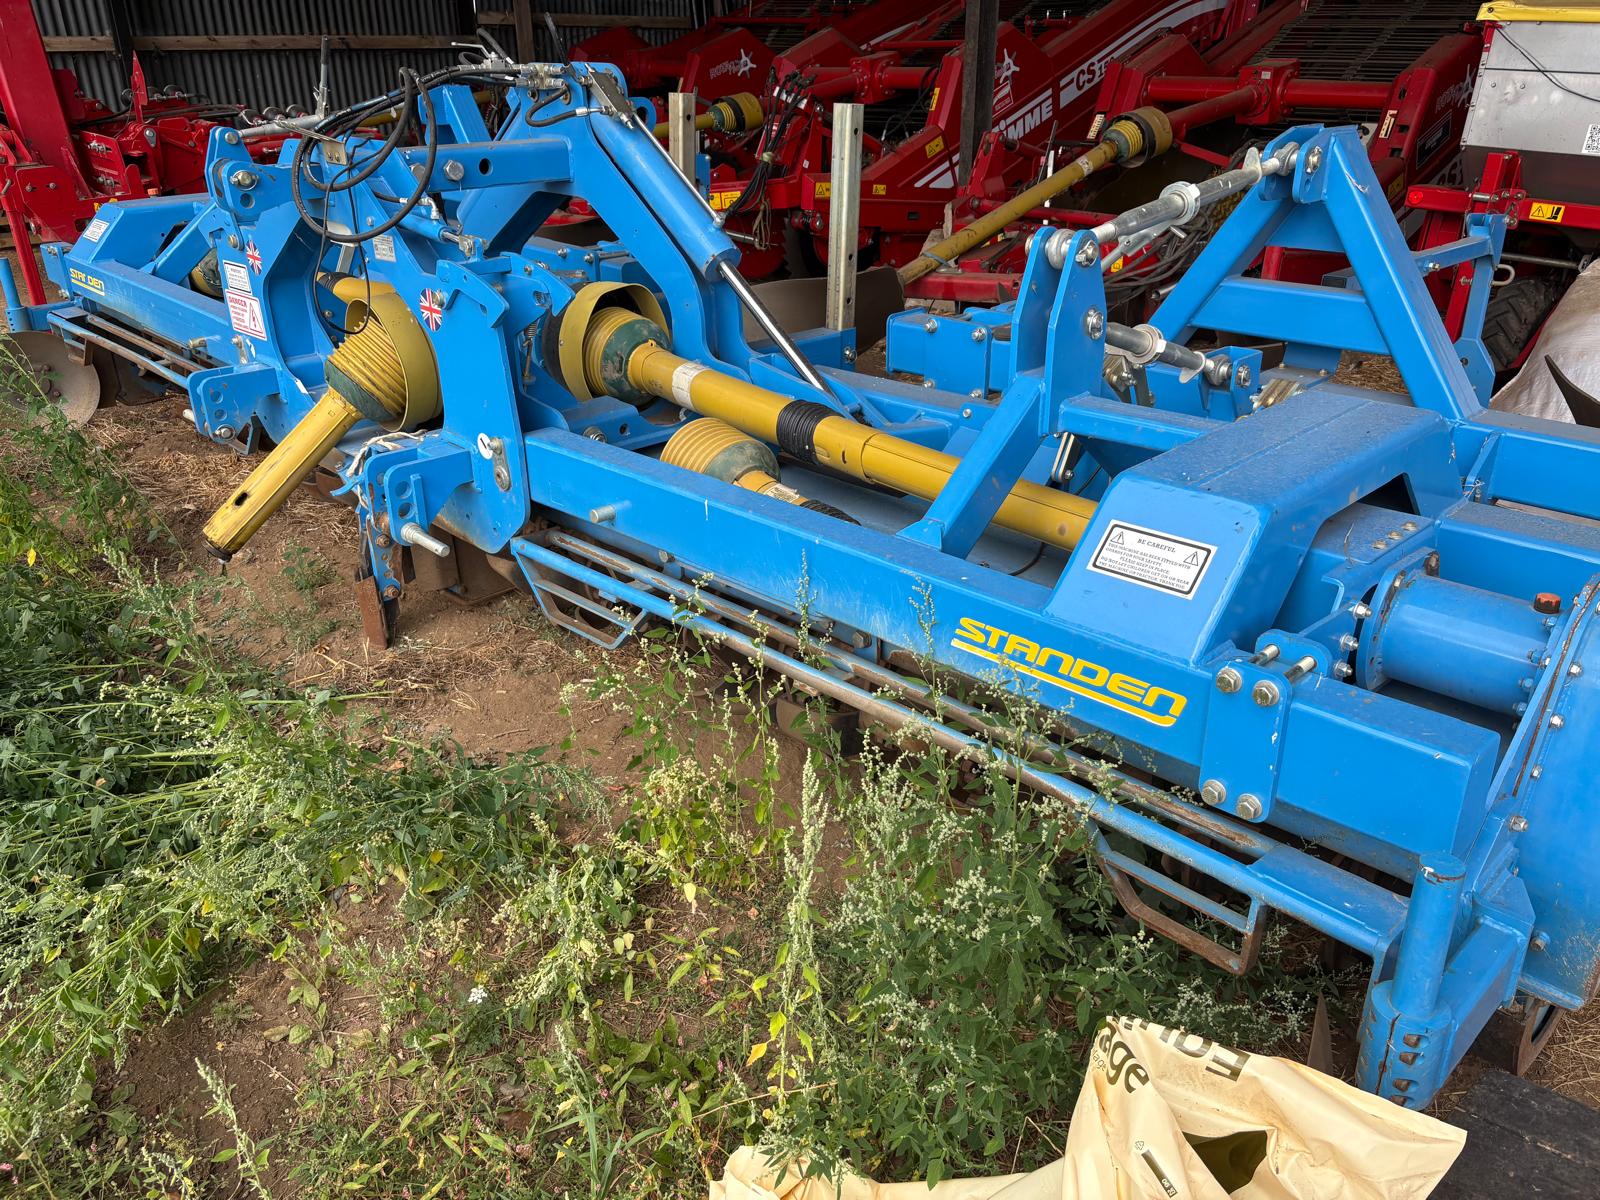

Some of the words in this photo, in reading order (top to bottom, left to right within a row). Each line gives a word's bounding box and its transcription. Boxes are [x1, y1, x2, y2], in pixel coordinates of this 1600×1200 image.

[1075, 61, 1097, 91] CS
[1117, 545, 1139, 555] MACHINE
[1146, 540, 1176, 553] CAREFUL
[1126, 563, 1150, 574] CHILDREN
[955, 617, 1188, 717] STANDEN
